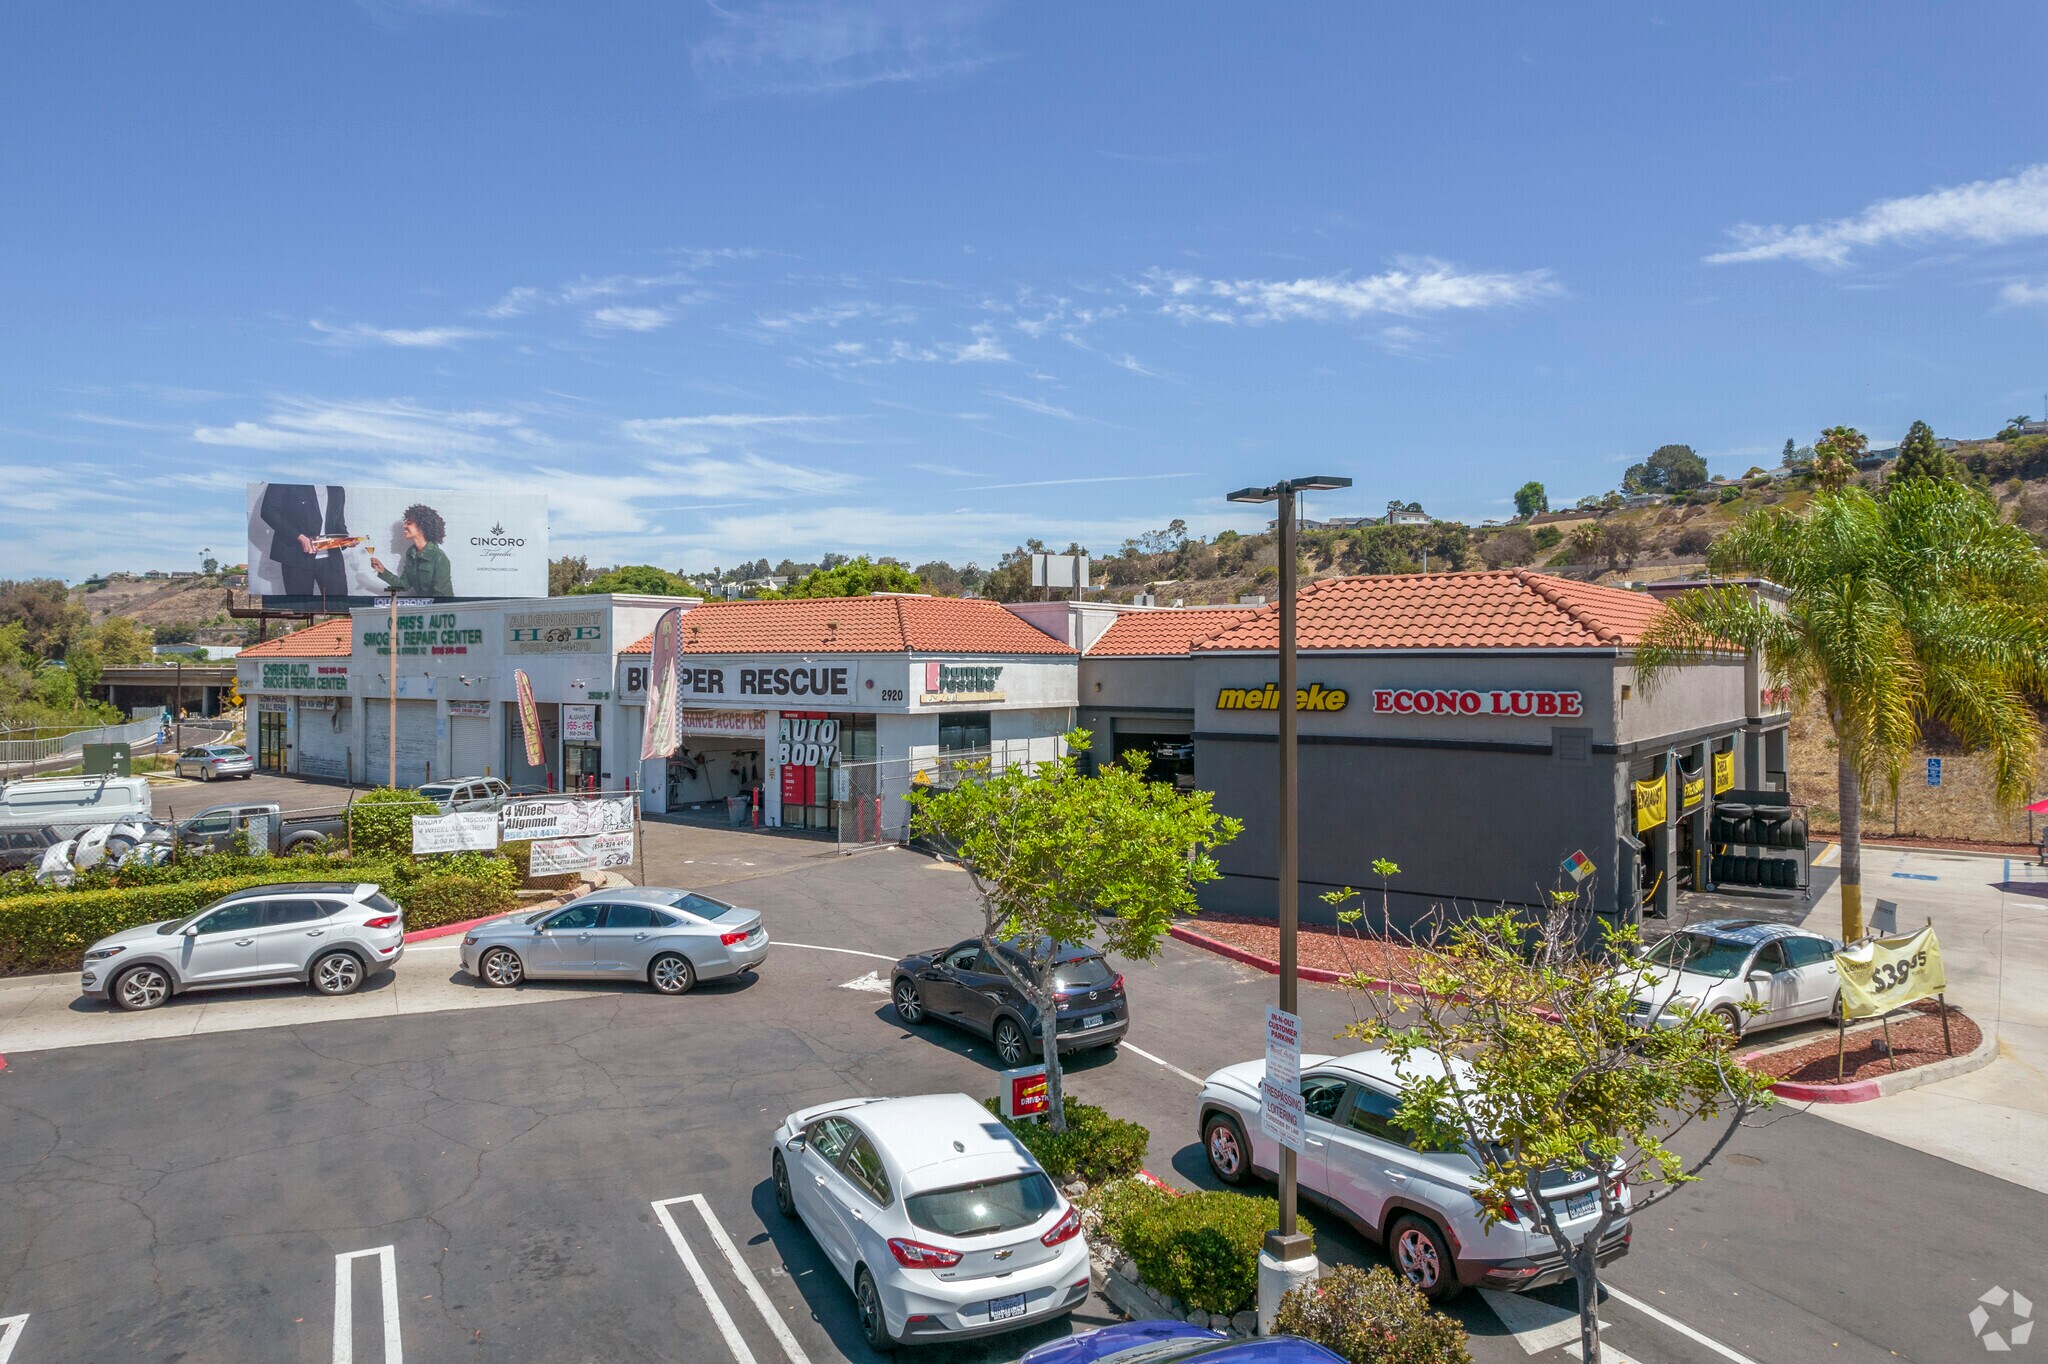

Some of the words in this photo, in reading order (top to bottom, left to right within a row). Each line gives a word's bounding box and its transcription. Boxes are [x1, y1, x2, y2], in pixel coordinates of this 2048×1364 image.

[470, 537, 525, 547] CINCORO
[376, 598, 430, 606] OUFRONT
[387, 615, 424, 630] CRIS'S
[429, 614, 456, 629] AUTO
[510, 612, 601, 627] ALIGNMENT
[363, 632, 389, 646] SMOG
[404, 631, 438, 645] REPAIR
[440, 629, 483, 645] CENTER
[263, 664, 289, 676] CHRIS'S
[290, 664, 309, 676] AUTO
[939, 664, 1003, 681] bumper
[263, 677, 283, 688] SMOG
[284, 677, 289, 688] &
[290, 677, 316, 689] REPAIR
[316, 677, 347, 690] CENTER
[628, 667, 723, 694] BPER
[740, 667, 848, 695] RESCUE
[881, 690, 903, 701] 2920
[1373, 691, 1482, 712] ECONO
[1490, 692, 1581, 716] LUBE
[779, 719, 836, 744] AUTO
[779, 743, 835, 769] BODY
[505, 806, 512, 817] 4
[514, 804, 546, 817] Wheel
[504, 816, 558, 830] Alignment
[1271, 1013, 1295, 1028] IN-N-OUT
[1268, 1021, 1298, 1038] CUSTOMER
[1271, 1030, 1295, 1045] PARKING
[1020, 1095, 1049, 1106] DRIVE-TH
[1263, 1083, 1302, 1112] TRESPASSING
[1267, 1101, 1297, 1126] LOITERING
